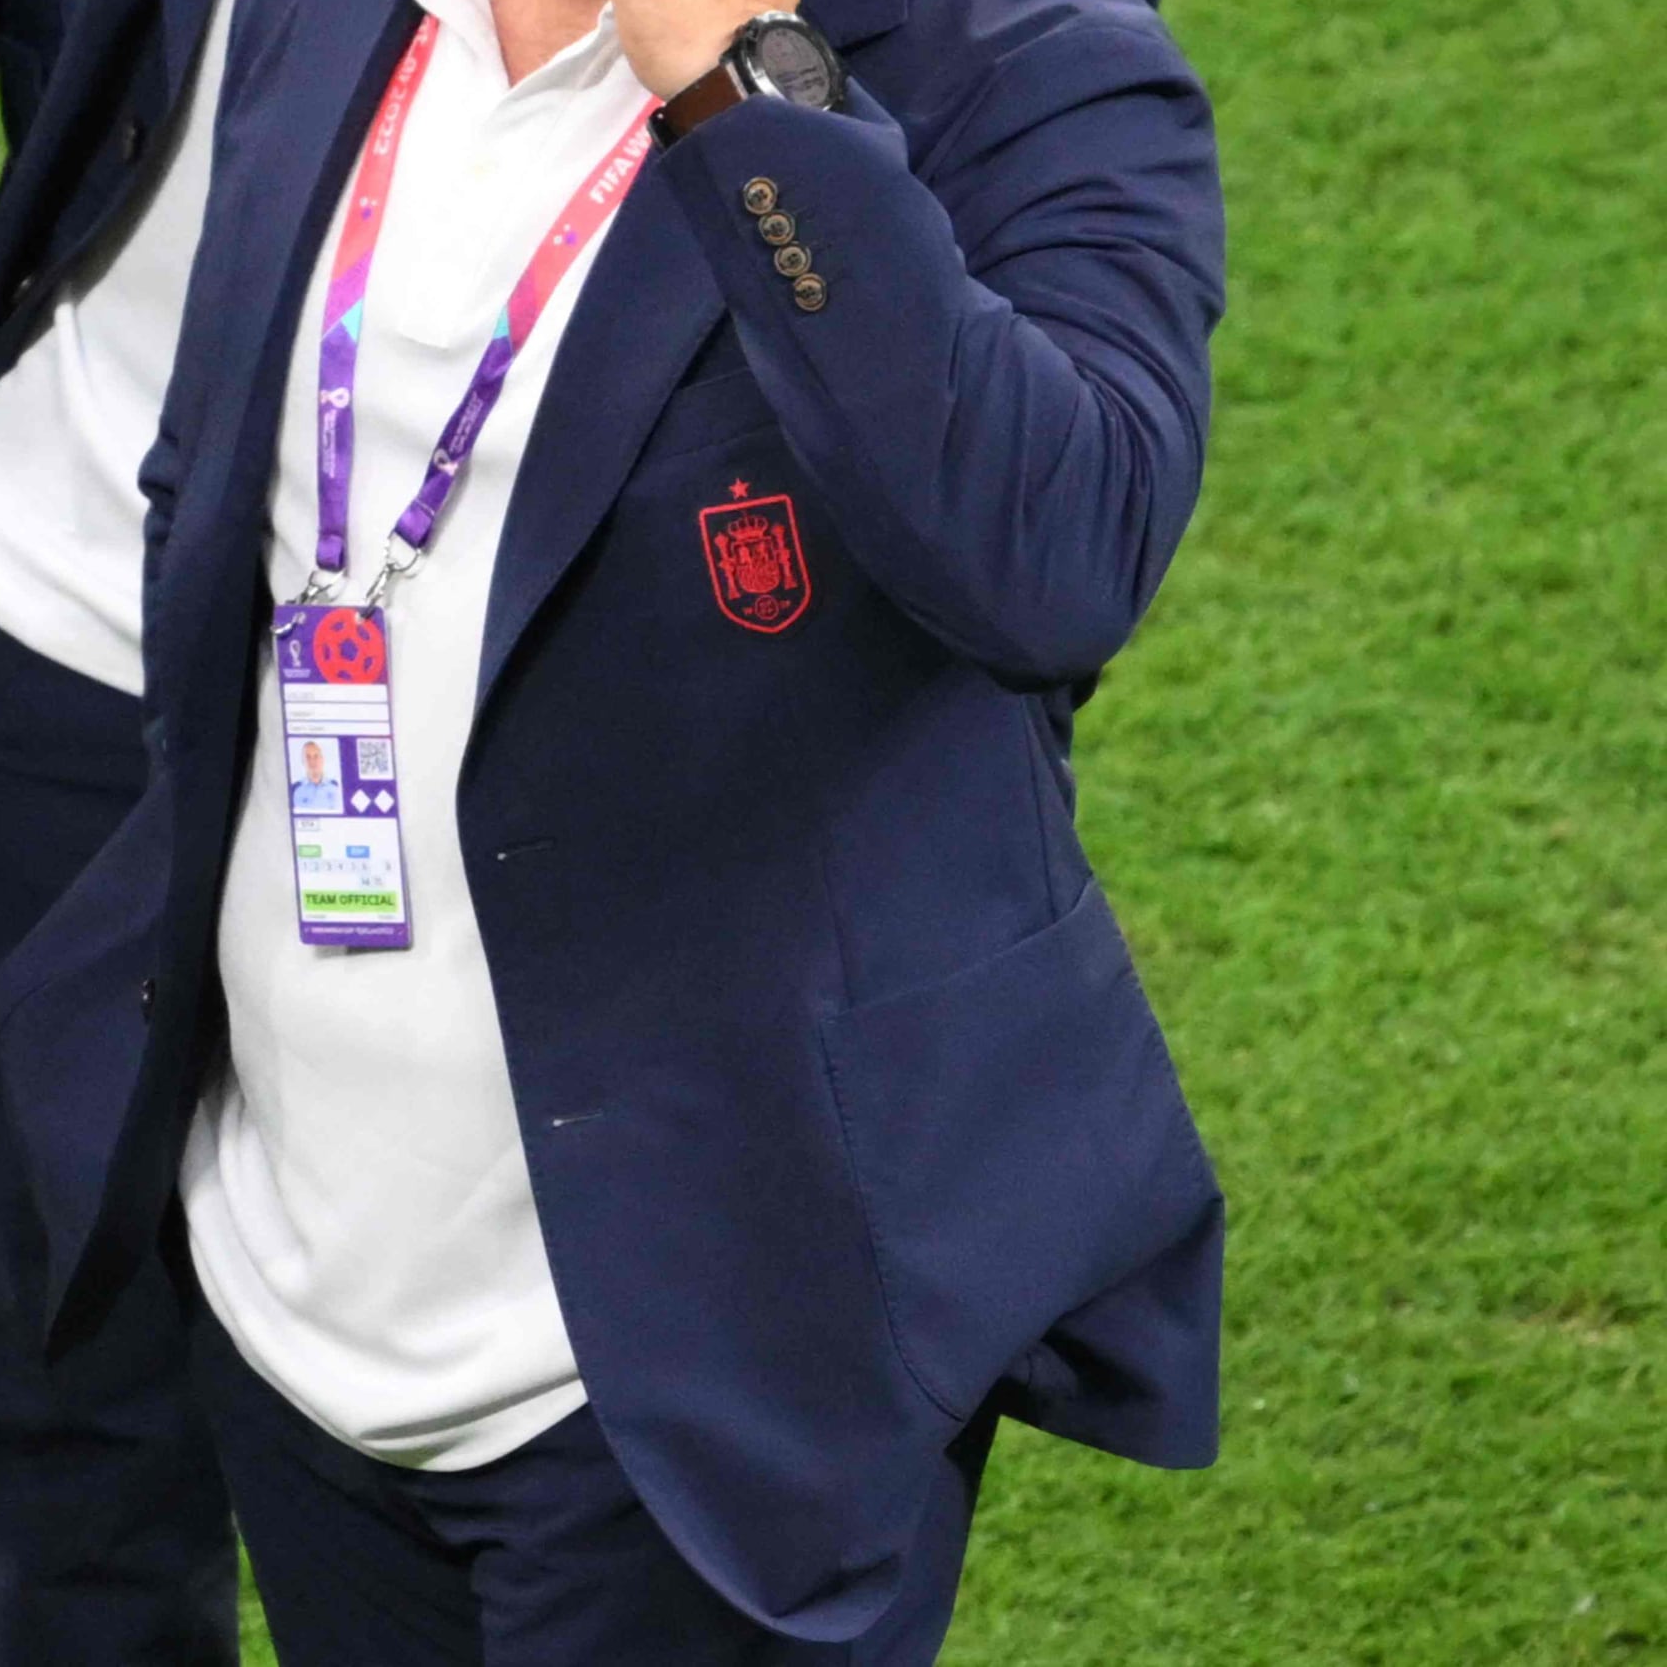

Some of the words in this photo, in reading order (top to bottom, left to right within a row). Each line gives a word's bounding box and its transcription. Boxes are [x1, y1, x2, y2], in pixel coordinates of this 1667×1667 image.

[588, 157, 635, 204] FIFA
[305, 892, 336, 906] TEAM
[339, 893, 395, 907] OFFICIAL
